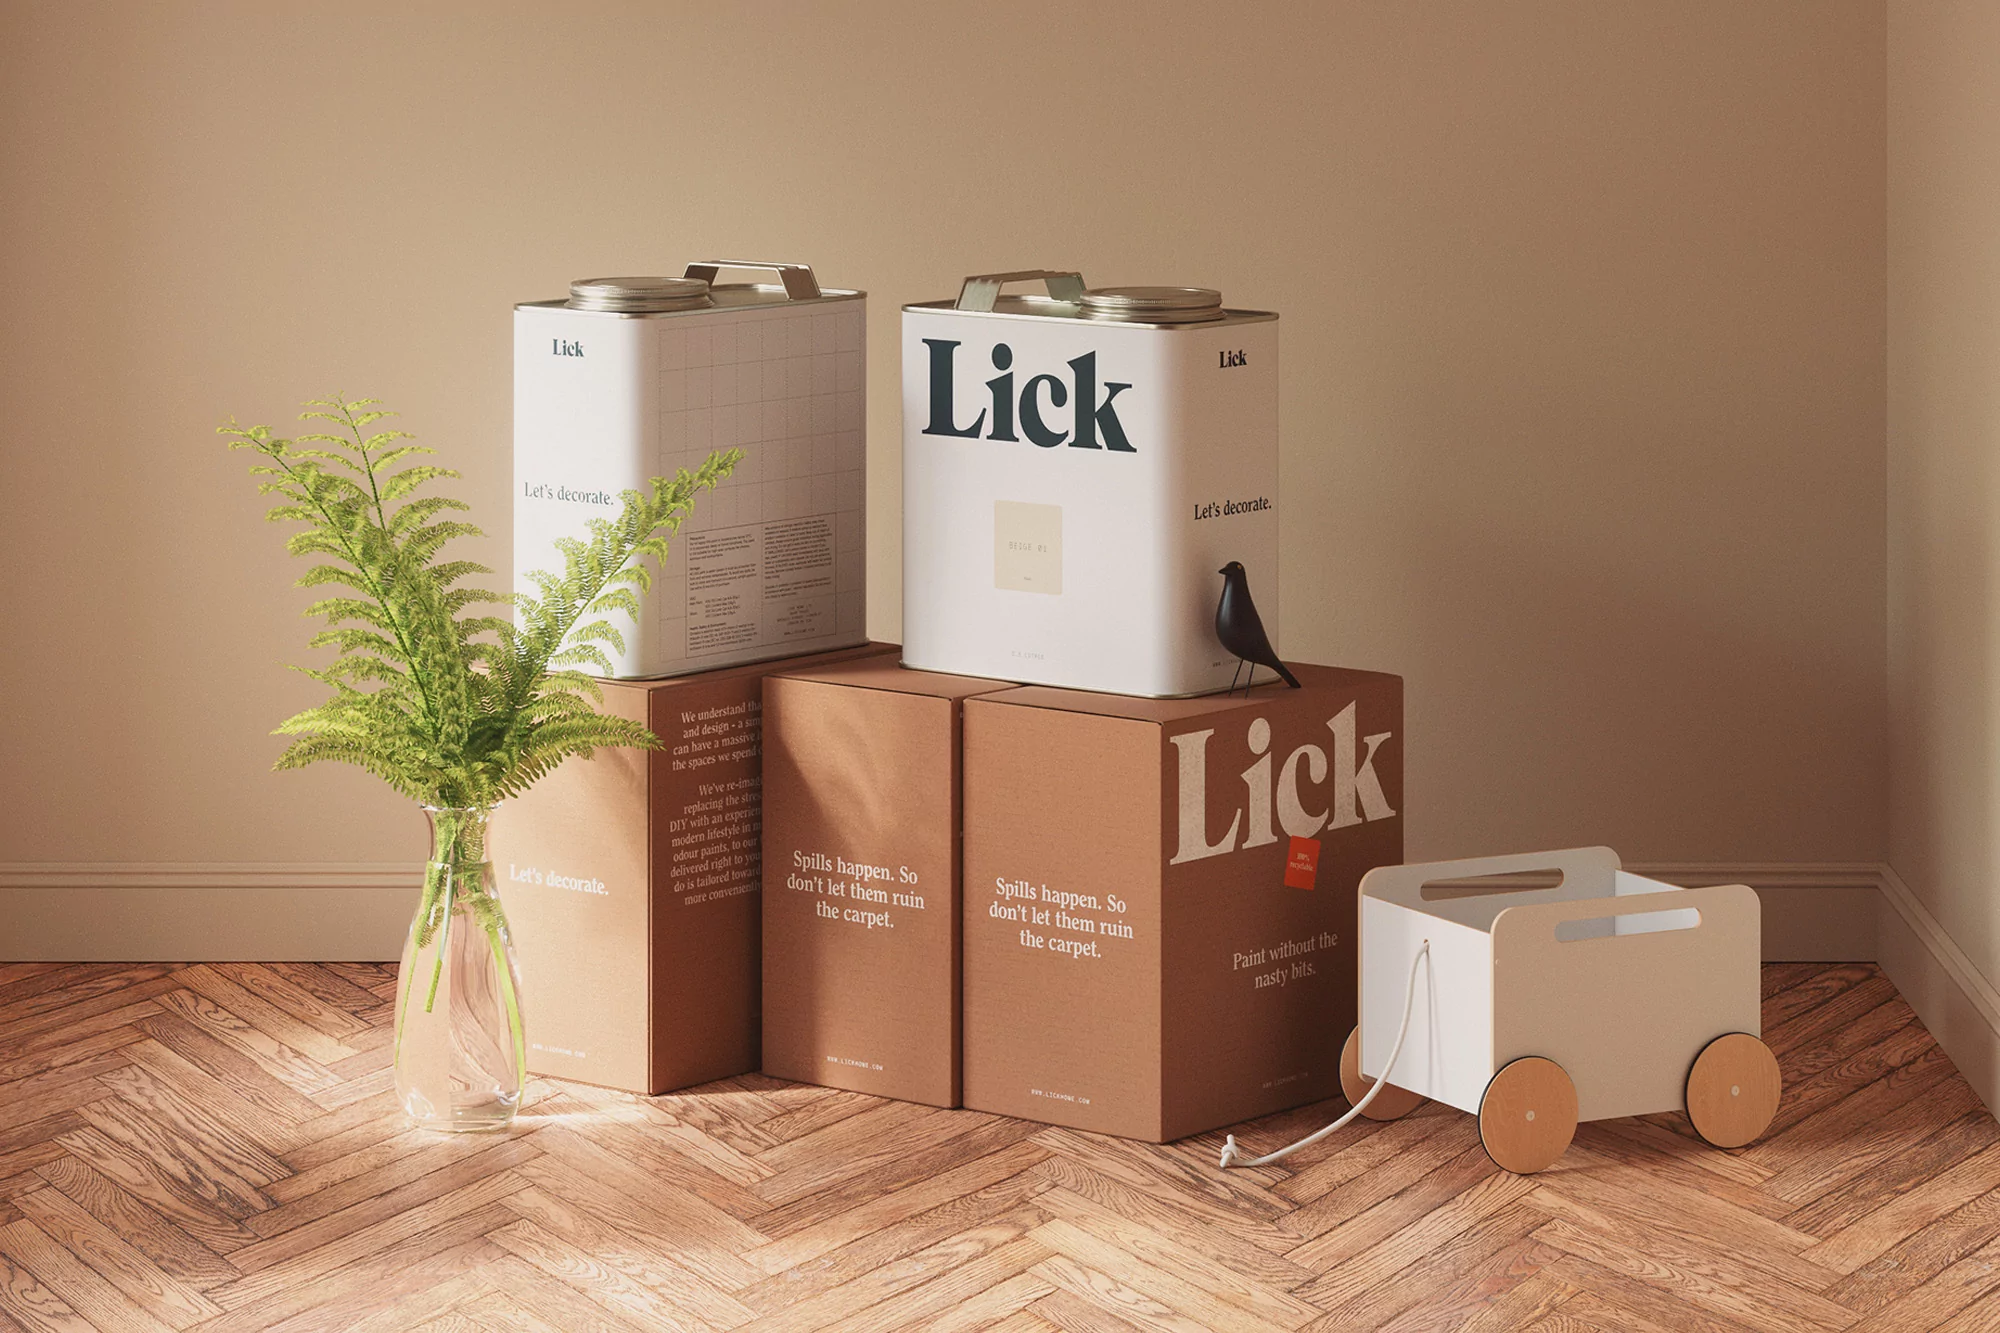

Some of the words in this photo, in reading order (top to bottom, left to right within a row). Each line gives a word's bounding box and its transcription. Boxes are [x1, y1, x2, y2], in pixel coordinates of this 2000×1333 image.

[552, 338, 584, 357] Lick
[1219, 349, 1247, 368] Lick
[922, 338, 1137, 453] Lick
[524, 482, 553, 500] Let's
[557, 485, 614, 506] decorate.
[1194, 502, 1220, 520] Let's
[1223, 496, 1272, 516] decorate.
[1009, 541, 1032, 551] BEIGE
[681, 711, 696, 723] We
[697, 702, 746, 720] understand
[683, 725, 700, 739] and
[701, 721, 729, 736] design
[738, 720, 743, 729] a
[673, 745, 689, 756] can
[691, 740, 712, 753] have
[714, 739, 719, 748] a
[721, 732, 755, 747] massive
[672, 759, 687, 771] the
[688, 754, 716, 770] spaces
[718, 752, 730, 762] we
[731, 745, 756, 762] spend
[699, 783, 725, 796] We've
[1170, 700, 1396, 865] Lick
[684, 798, 723, 815] replacing
[725, 795, 738, 807] the
[669, 818, 688, 833] DIY
[690, 814, 710, 828] with
[712, 814, 722, 824] an
[671, 833, 705, 847] modern
[707, 823, 740, 840] lifestyle
[742, 822, 751, 833] in
[673, 849, 699, 862] odour
[701, 843, 730, 859] paints,
[732, 839, 740, 850] to
[743, 837, 758, 847] our
[670, 860, 709, 878] delivered
[711, 855, 732, 871] right
[734, 854, 743, 864] to
[793, 850, 832, 872] Spills
[837, 856, 895, 881] happen.
[899, 865, 918, 885] So
[510, 863, 542, 884] Let's
[546, 870, 609, 895] decorate.
[674, 881, 685, 892] do
[687, 878, 695, 890] is
[697, 871, 730, 887] tailored
[787, 873, 823, 893] don't
[828, 879, 846, 897] let
[850, 883, 888, 904] them
[892, 891, 925, 909] ruin
[684, 893, 707, 906] more
[996, 877, 1037, 900] Spills
[1041, 884, 1102, 910] happen.
[1107, 894, 1127, 914] So
[816, 901, 839, 919] the
[843, 908, 894, 929] carpet.
[989, 901, 1027, 922] don't
[1031, 906, 1051, 926] let
[1055, 911, 1095, 933] them
[1099, 920, 1134, 939] ruin
[1019, 929, 1044, 948] the
[1048, 937, 1102, 959] carpet.
[1233, 948, 1266, 971] Paint
[1269, 936, 1316, 961] without
[1319, 931, 1338, 949] the
[1254, 967, 1288, 989] nasty
[1291, 961, 1317, 980] bits.
